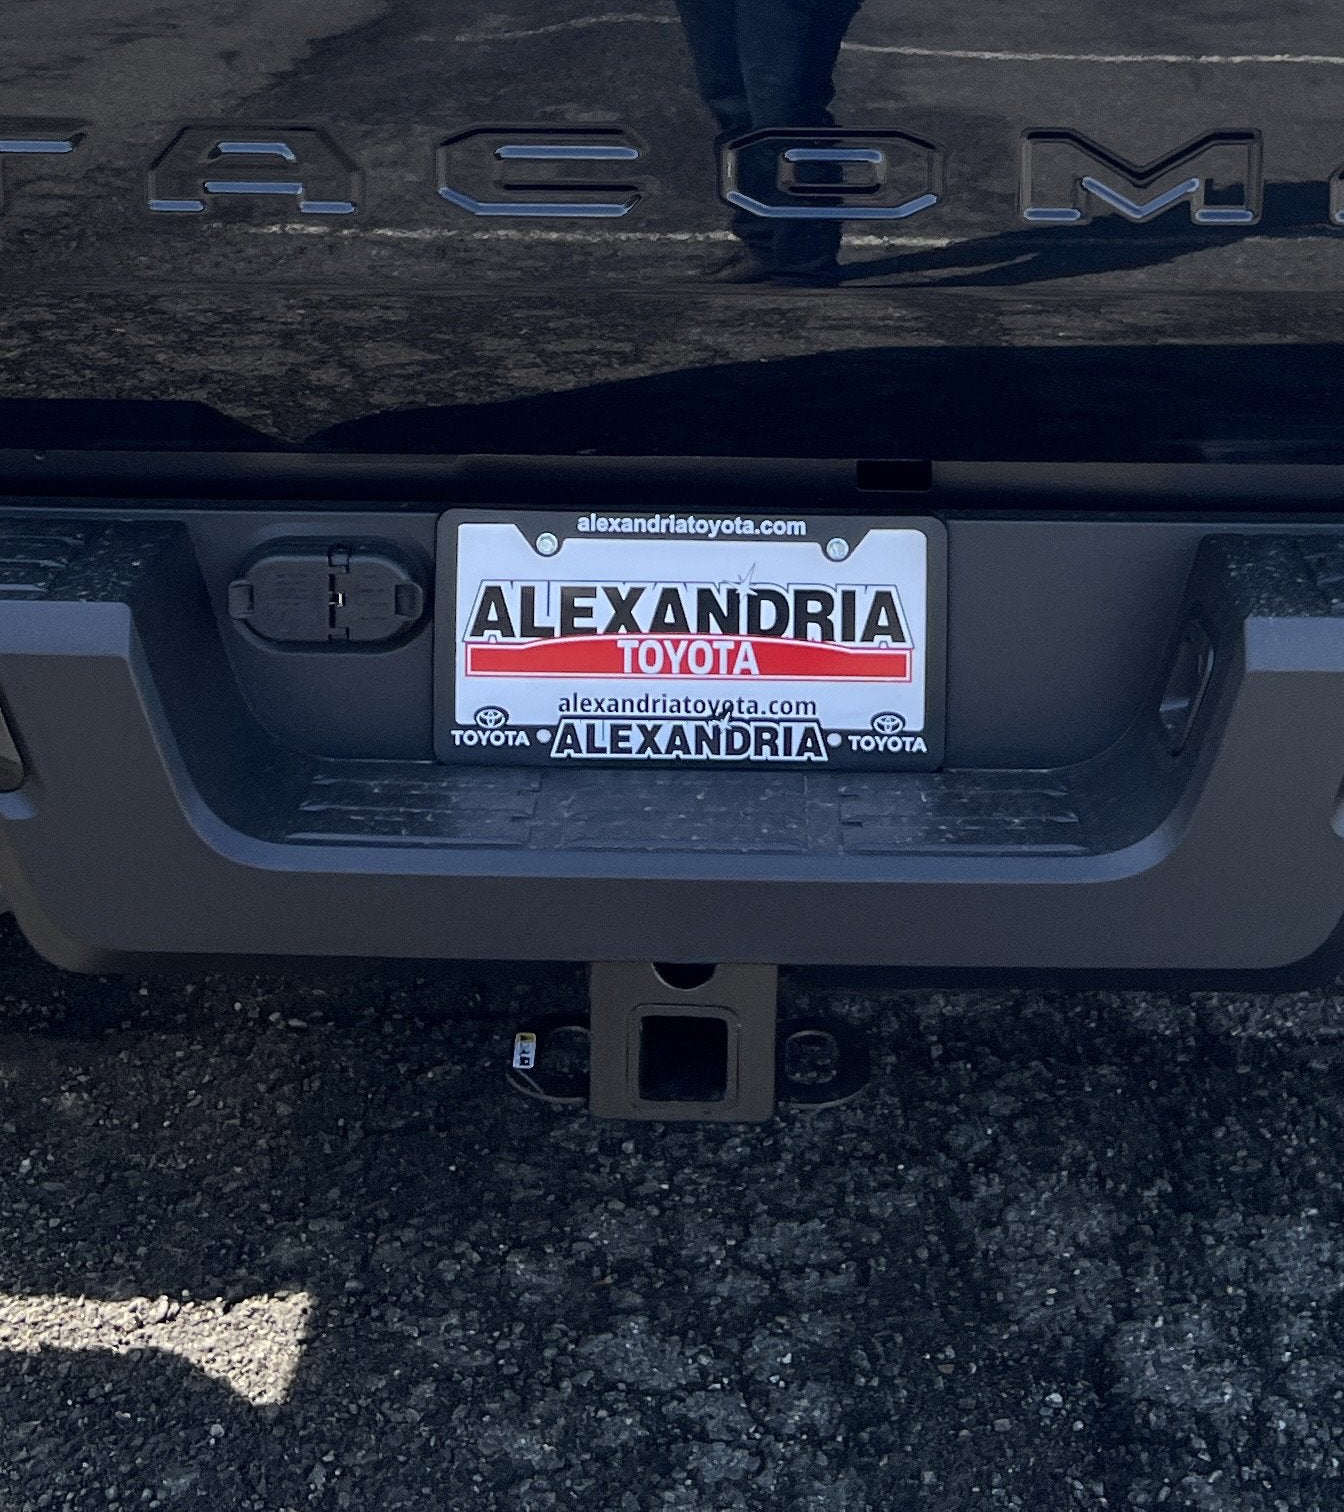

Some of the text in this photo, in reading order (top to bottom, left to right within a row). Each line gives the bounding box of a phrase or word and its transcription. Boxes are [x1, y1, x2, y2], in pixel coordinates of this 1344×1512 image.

[576, 513, 807, 539] alexandriatoyota.com
[470, 584, 907, 644] ALEXANDRIA
[616, 638, 761, 677] TOYOTA
[558, 693, 818, 717] alexandriatoyota.com
[450, 729, 531, 749] TOYOTA
[552, 718, 828, 762] ALEXANDRIA
[847, 734, 928, 754] TOYOTA
